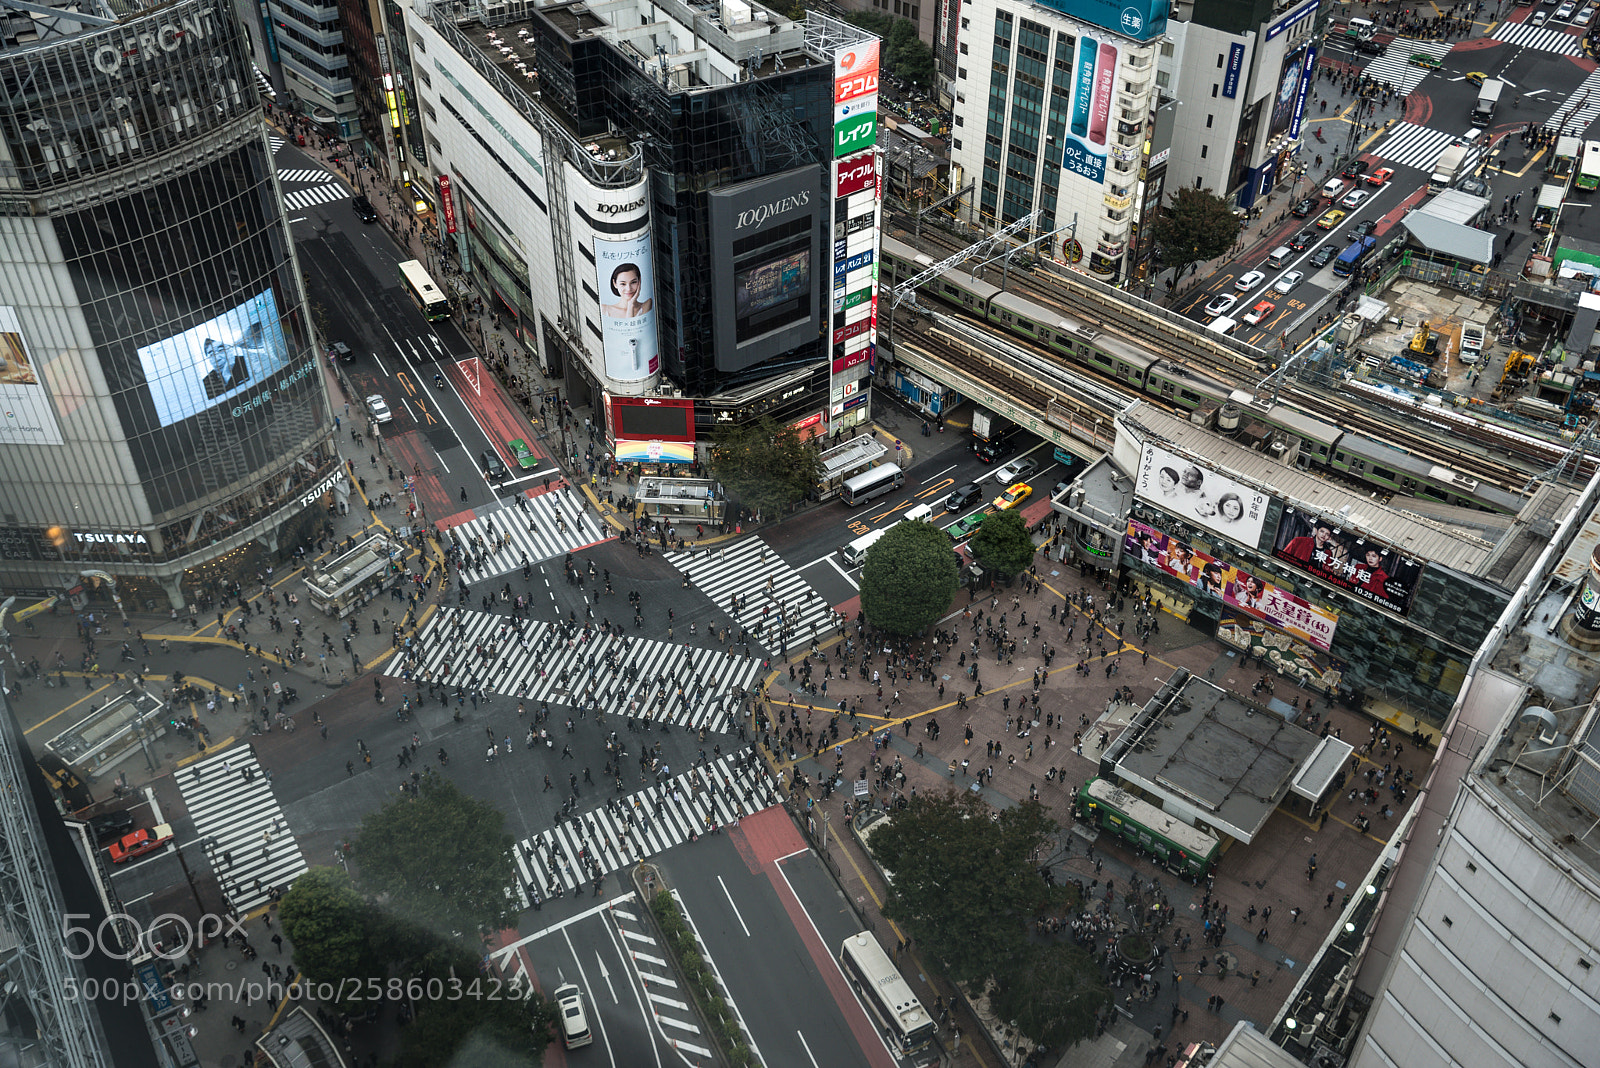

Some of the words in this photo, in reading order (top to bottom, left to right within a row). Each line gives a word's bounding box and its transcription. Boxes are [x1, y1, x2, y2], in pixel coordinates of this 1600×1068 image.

[1232, 47, 1241, 71] MIZUHO
[839, 75, 878, 99] アコム
[838, 121, 873, 146] レイク
[838, 163, 874, 185] アイフル
[1068, 160, 1098, 179] うるおう
[846, 294, 861, 306] レイク
[1286, 298, 1307, 310] 8-20
[835, 324, 861, 341] アコム
[1141, 448, 1154, 488] ありがとう
[299, 470, 344, 508] TSUTAYA
[74, 532, 147, 544] TSUTAYA
[847, 520, 871, 535] 8-20
[1314, 549, 1372, 584] 東方神起
[1353, 586, 1374, 600] 10.25
[1373, 595, 1402, 613] Release
